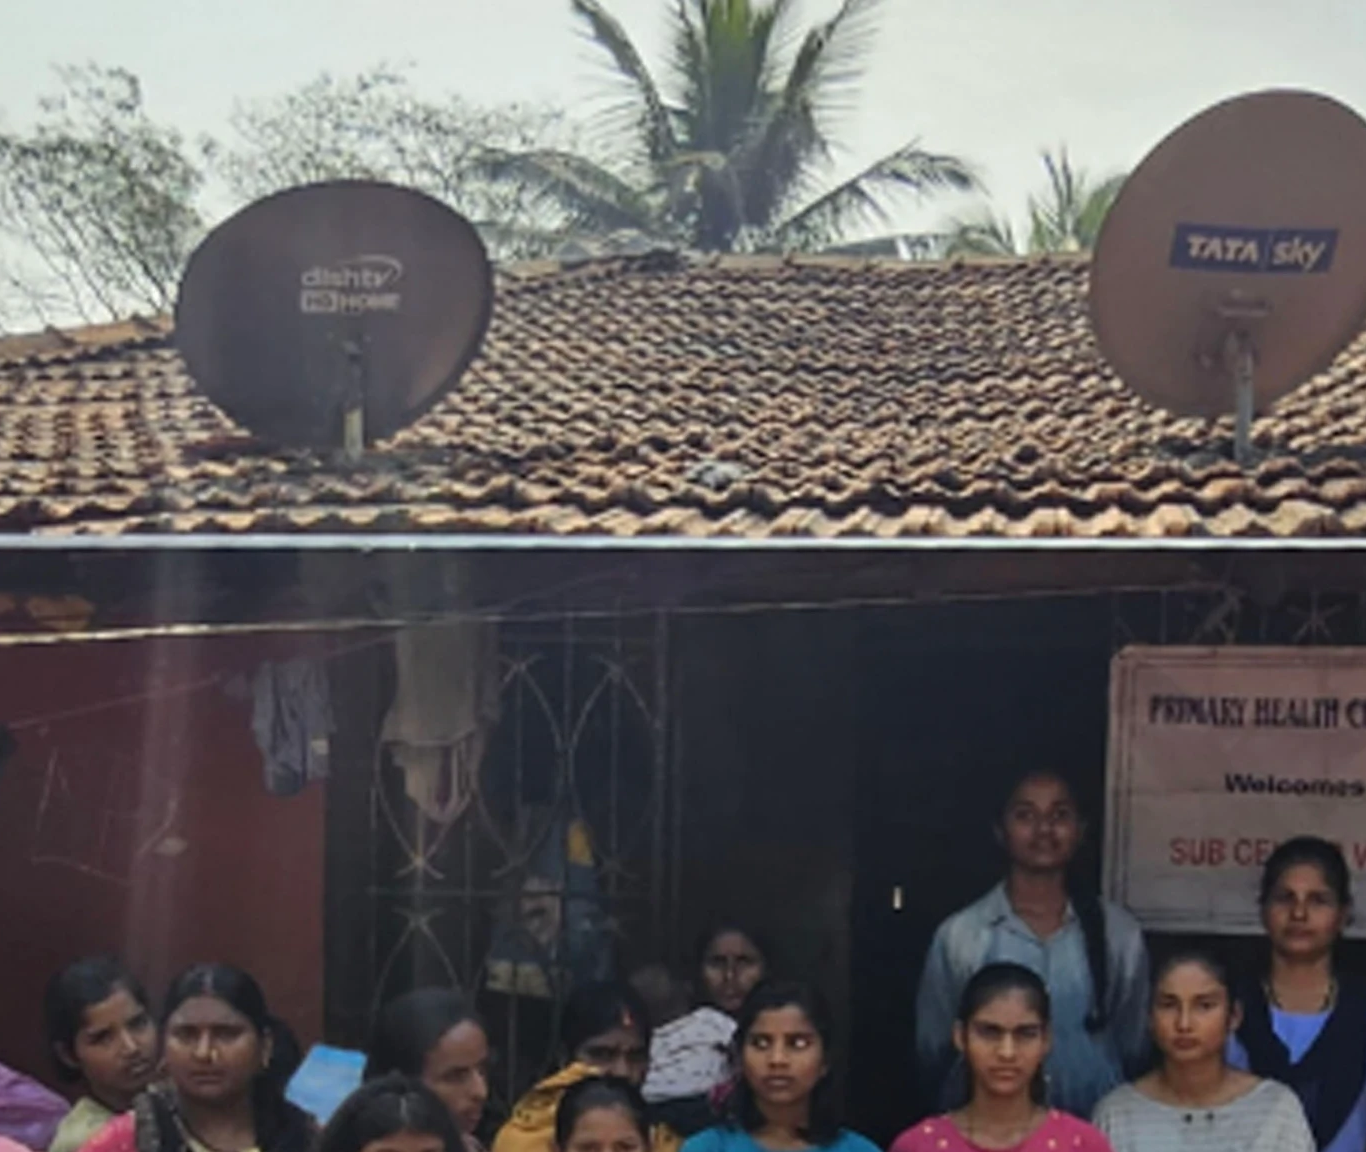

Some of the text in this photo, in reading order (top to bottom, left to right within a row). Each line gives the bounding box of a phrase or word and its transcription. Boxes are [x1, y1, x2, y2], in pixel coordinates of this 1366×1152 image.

[1188, 235, 1327, 272] TATA sky
[1148, 694, 1244, 728] PRIMARY
[1254, 697, 1336, 728] HEALTH
[1225, 773, 1365, 797] Welcomes
[1169, 838, 1225, 866] SUB
